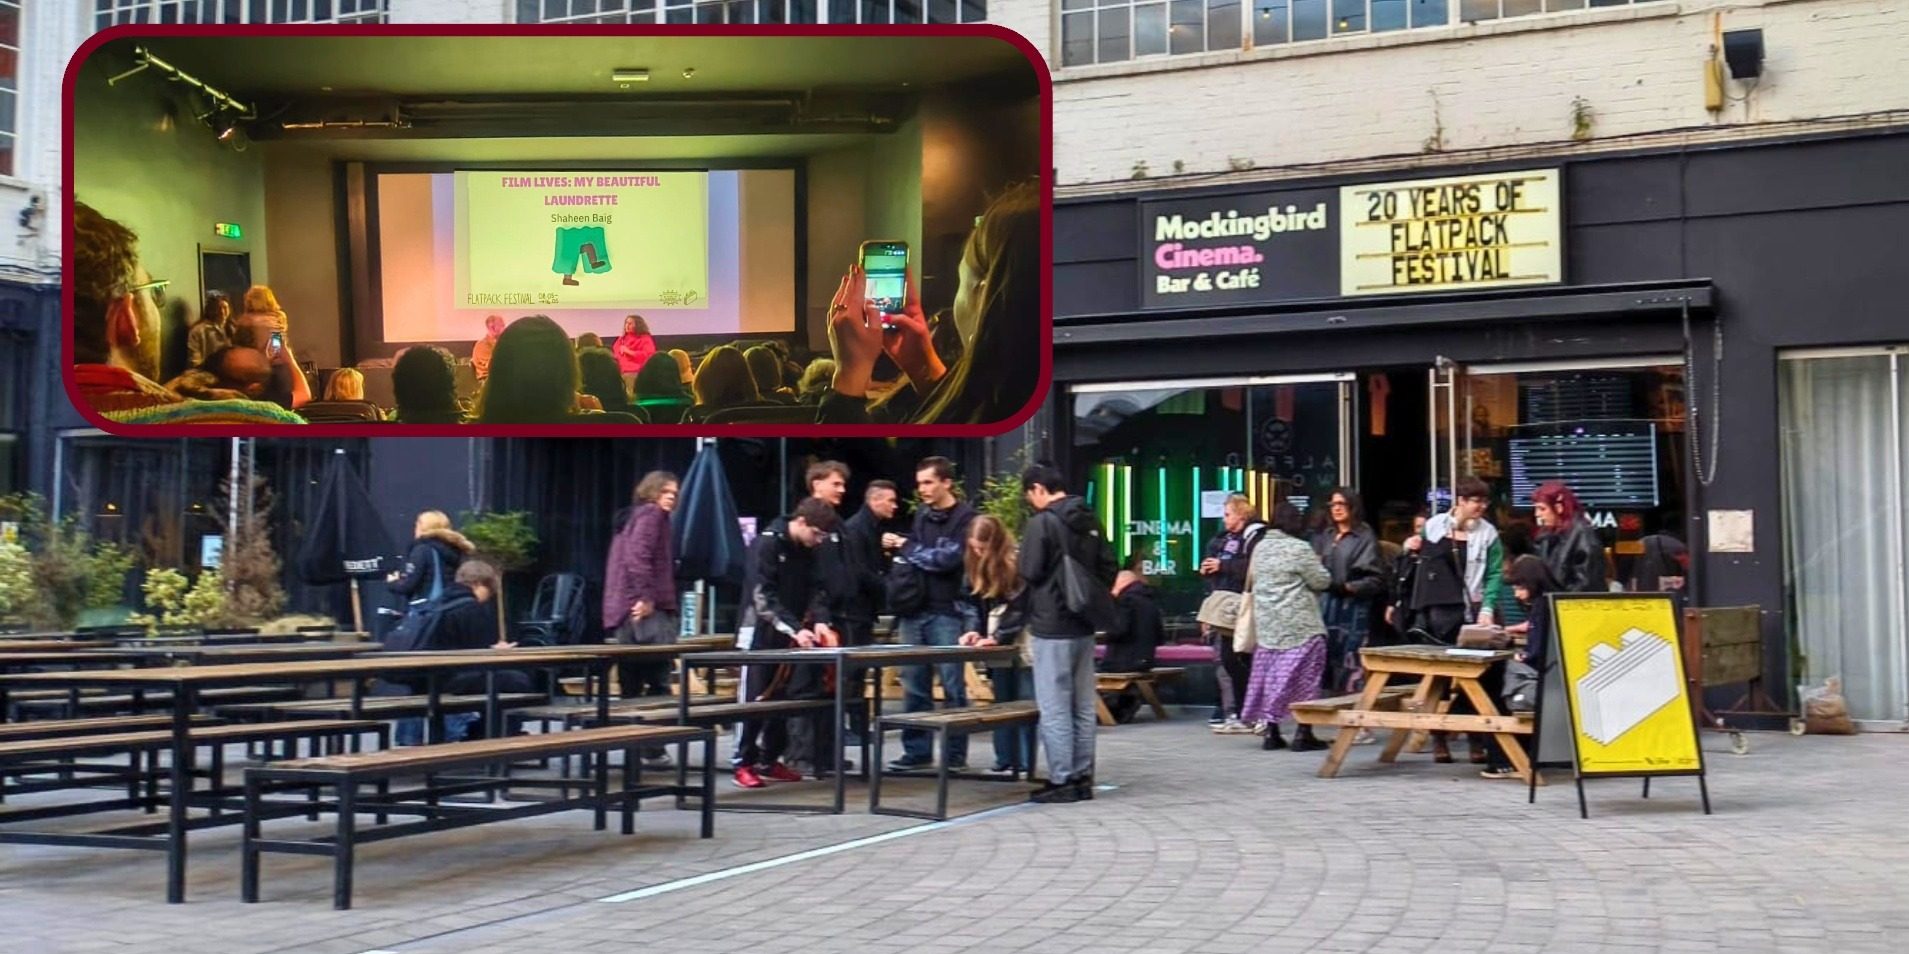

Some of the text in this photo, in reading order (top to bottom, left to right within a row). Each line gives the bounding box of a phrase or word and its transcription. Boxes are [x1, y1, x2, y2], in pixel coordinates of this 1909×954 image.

[501, 176, 661, 188] FILM LIVES: MY BEAUTIFUL
[544, 195, 618, 206] LAUNDRETTE
[1368, 180, 1525, 221] 20 YEARS OF
[551, 213, 613, 225] Shaheen Baig
[1155, 203, 1327, 241] Mockingbird
[1391, 215, 1509, 252] FLATPACK
[1155, 243, 1264, 269] Cinema.
[1392, 249, 1509, 285] FESTIVAL
[1156, 268, 1260, 294] Bar & Café
[467, 292, 535, 305] FLATPACK FESTIVAL
[1124, 520, 1193, 535] CINEMA
[1142, 560, 1176, 575] BAR
